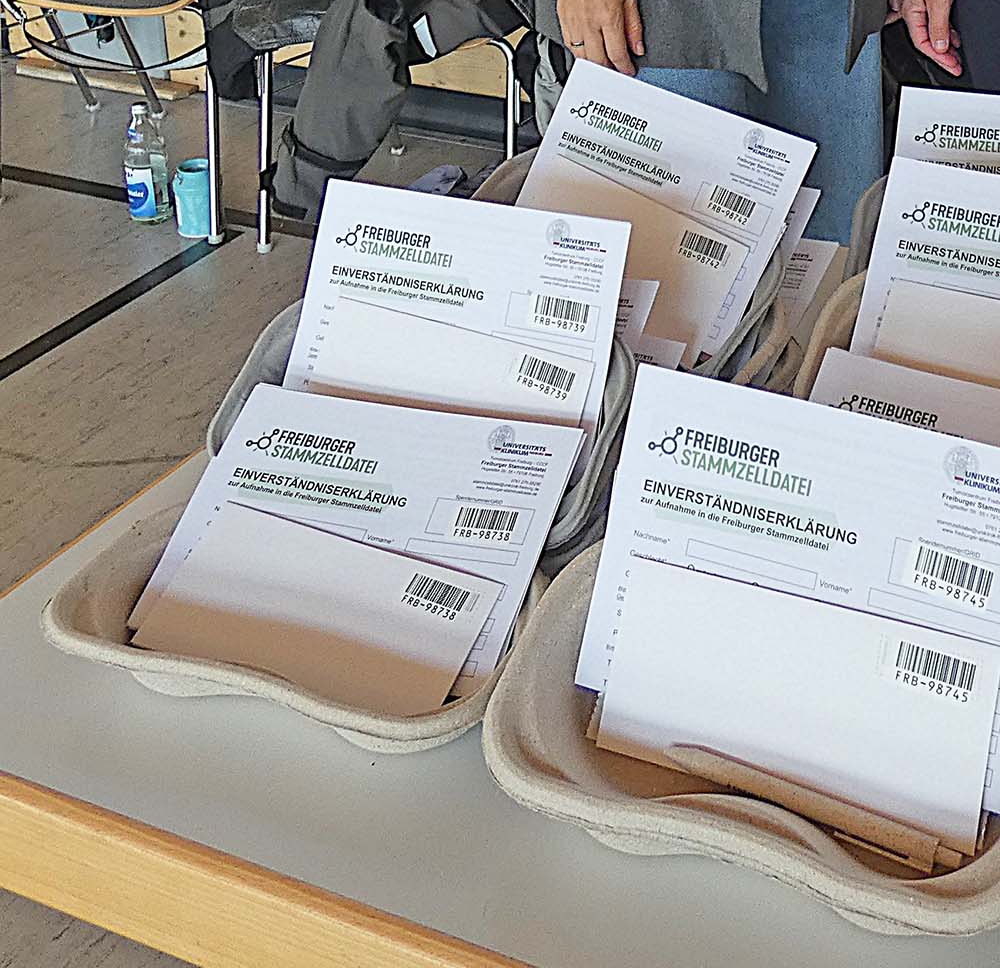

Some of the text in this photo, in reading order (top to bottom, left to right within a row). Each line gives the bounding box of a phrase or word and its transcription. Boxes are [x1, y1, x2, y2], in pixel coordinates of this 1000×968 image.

[592, 102, 648, 132] FREIBURGER
[588, 115, 663, 152] STAMMZELLDATEI
[562, 131, 681, 184] EINVERSTÄNDNISERKLÄRUNG
[362, 225, 431, 249] FREIBURGER
[360, 240, 453, 268] STAMMZELLDATEI
[543, 255, 568, 264] Freiburger
[332, 265, 485, 301] EINVERSTÄNDNISERKLÄRUNG
[960, 264, 994, 277] Freiburger
[388, 287, 418, 300] Freiburger
[534, 315, 586, 333] FRB-98739
[517, 375, 568, 401] FRB-98739
[858, 396, 938, 428] FREIBURGER
[278, 430, 356, 454] FREIBURGER
[684, 428, 780, 468] FREIBURGER
[271, 444, 379, 474] STAMMZELLDATEI
[481, 460, 507, 468] Freiburger
[680, 449, 812, 497] STAMMZELLDATEI
[228, 480, 239, 488] zur
[240, 482, 274, 494] Aufnahme
[282, 489, 293, 498] die
[294, 492, 330, 505] Freiburger
[330, 498, 383, 514] Stammzelldatei
[233, 467, 407, 508] EINVERSTÄNDNISERKLÄRUNG
[942, 492, 976, 507] Freiburger
[964, 479, 1000, 494] KLINIKUM
[640, 496, 830, 552] zur Aufnahme in die Freiburger Stammzelldatei
[643, 479, 858, 545] EINVERSTÄNDNISERKLÄRUNG
[453, 528, 510, 541] FRB-98738
[913, 573, 986, 609] FRB-98745
[401, 594, 456, 621] FRB-98738
[895, 670, 969, 704] FRB-98745
